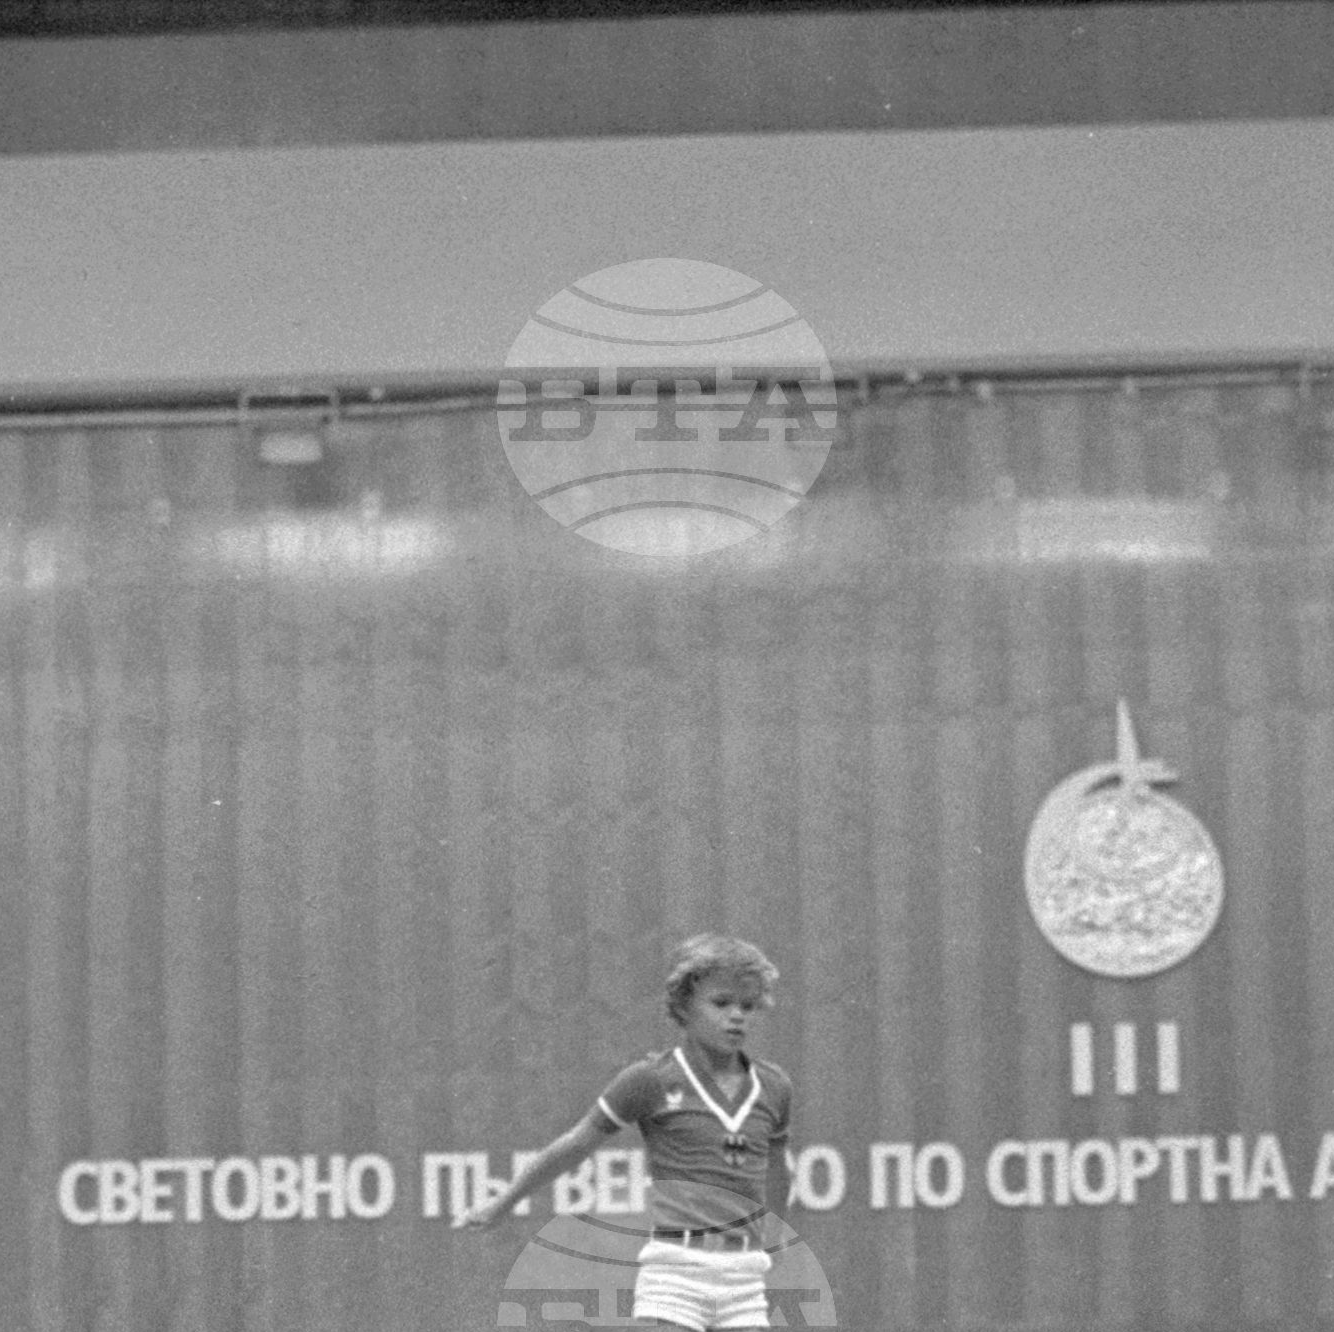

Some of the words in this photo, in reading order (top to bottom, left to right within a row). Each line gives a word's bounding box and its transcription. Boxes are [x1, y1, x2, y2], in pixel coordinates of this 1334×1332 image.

[1070, 1022, 1181, 1096] III
[58, 1152, 396, 1225] СВЕТОВНО
[869, 1141, 966, 1210] ПО
[986, 1134, 1293, 1206] СПОРТНА
